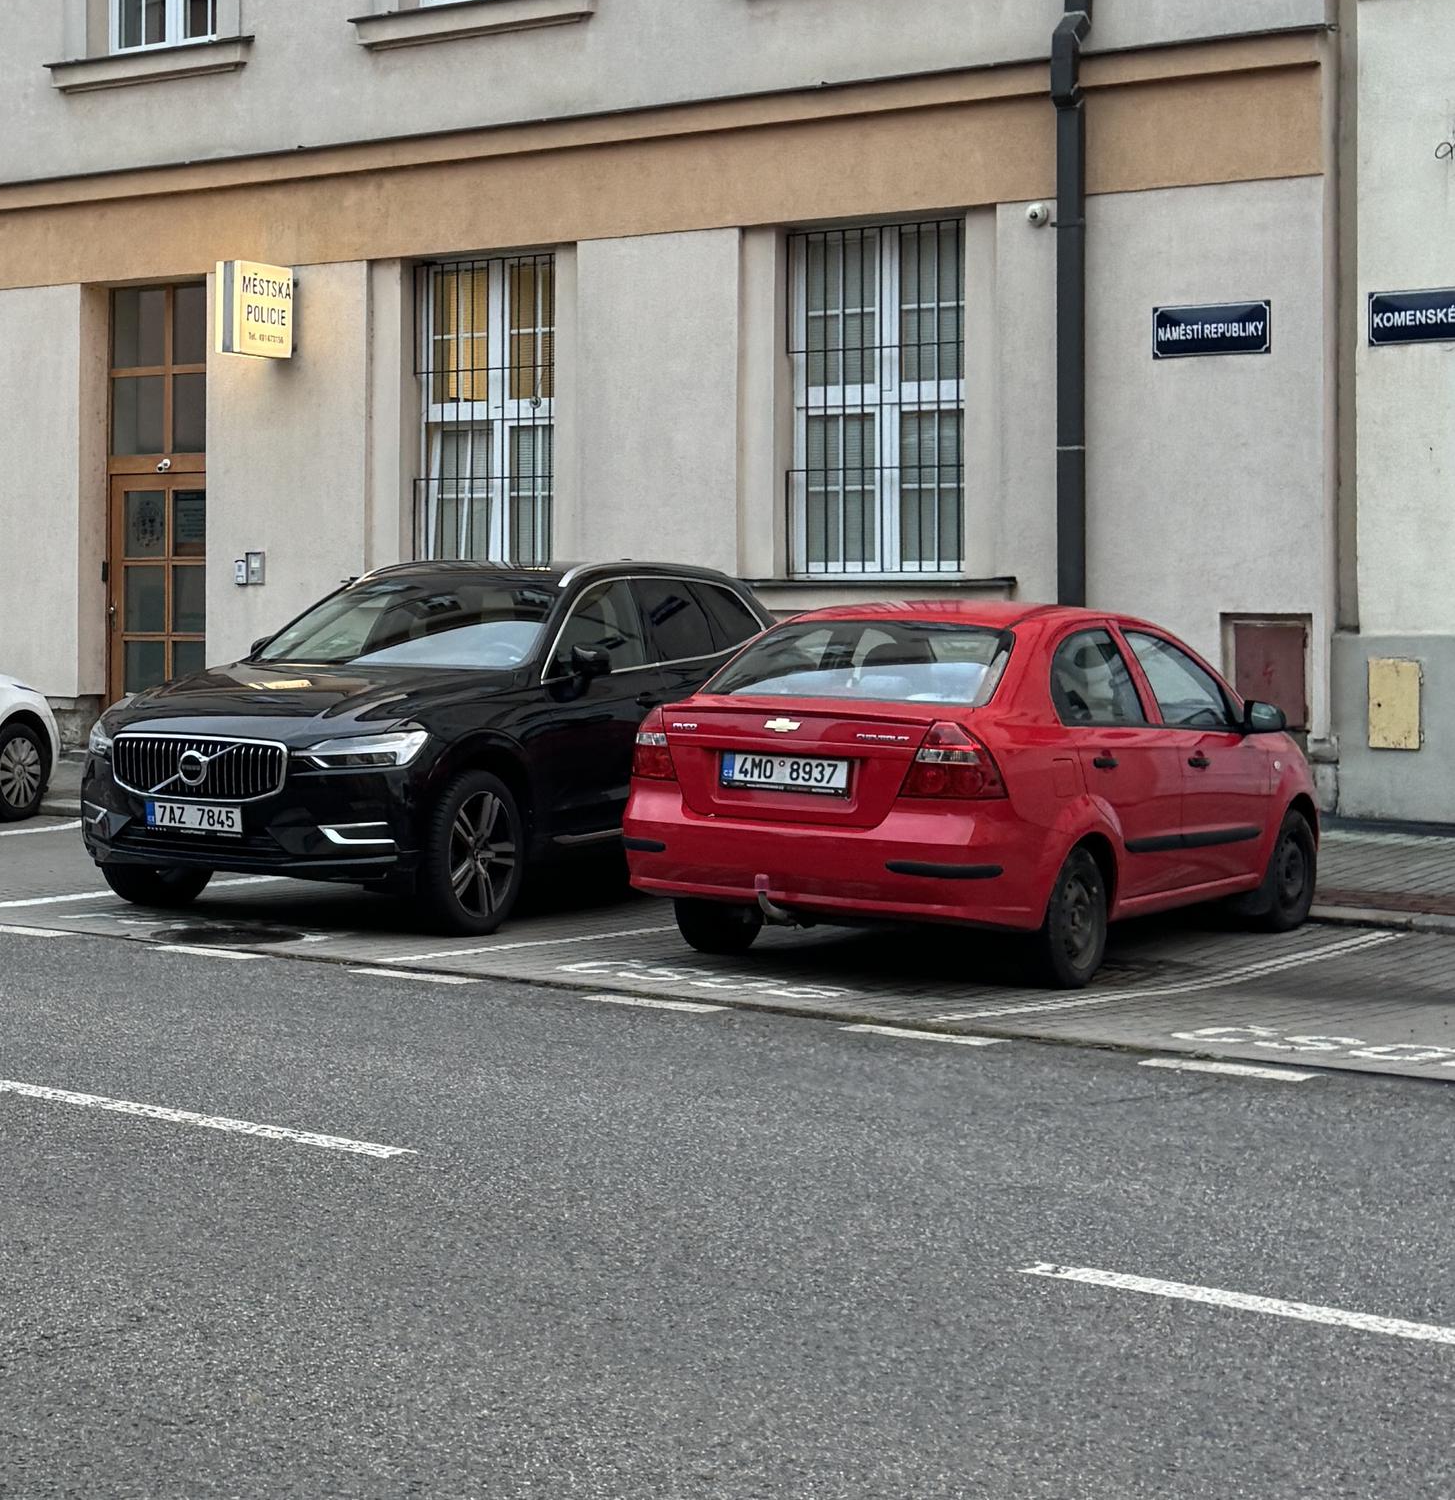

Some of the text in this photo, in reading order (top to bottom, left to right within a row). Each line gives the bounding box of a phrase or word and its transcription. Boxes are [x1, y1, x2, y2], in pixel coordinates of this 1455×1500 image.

[242, 272, 292, 300] MĚSTSKÁ
[246, 304, 287, 327] POLICIE
[1372, 304, 1455, 329] KOMENSKÉ
[1157, 320, 1264, 342] NÁMĚSTÍ REPUBLIKY
[788, 759, 838, 785] 8937
[157, 804, 235, 829] 7AZ 7845
